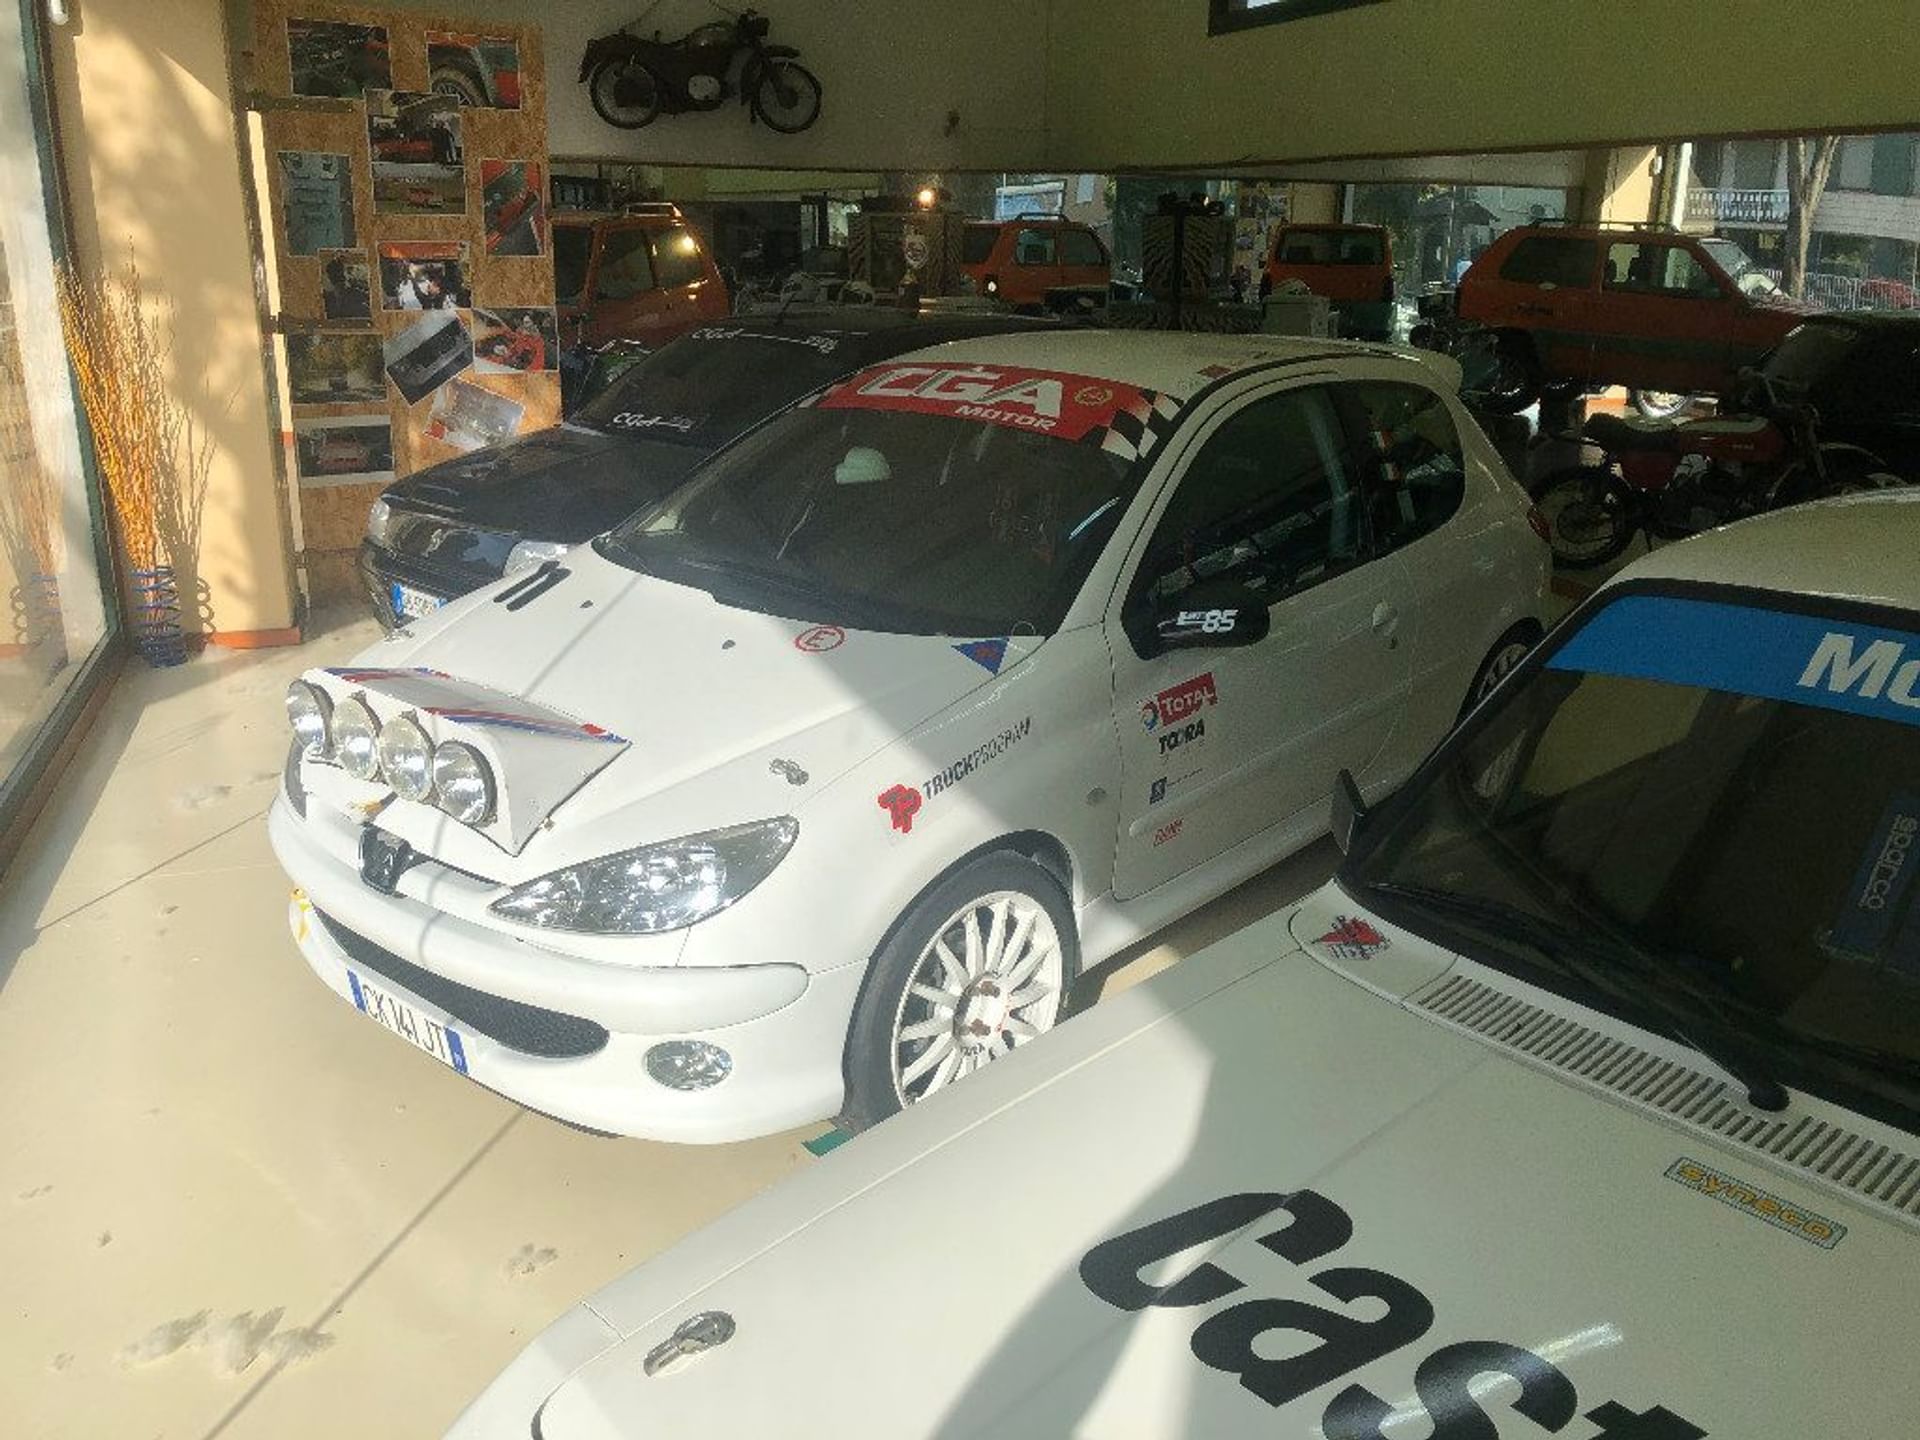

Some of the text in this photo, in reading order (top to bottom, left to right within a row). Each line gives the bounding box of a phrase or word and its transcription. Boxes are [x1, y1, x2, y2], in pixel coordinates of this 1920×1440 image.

[857, 366, 1063, 420] CGA
[954, 404, 1058, 432] MOTOR
[1202, 608, 1239, 634] 85
[1161, 685, 1216, 716] TOTAL
